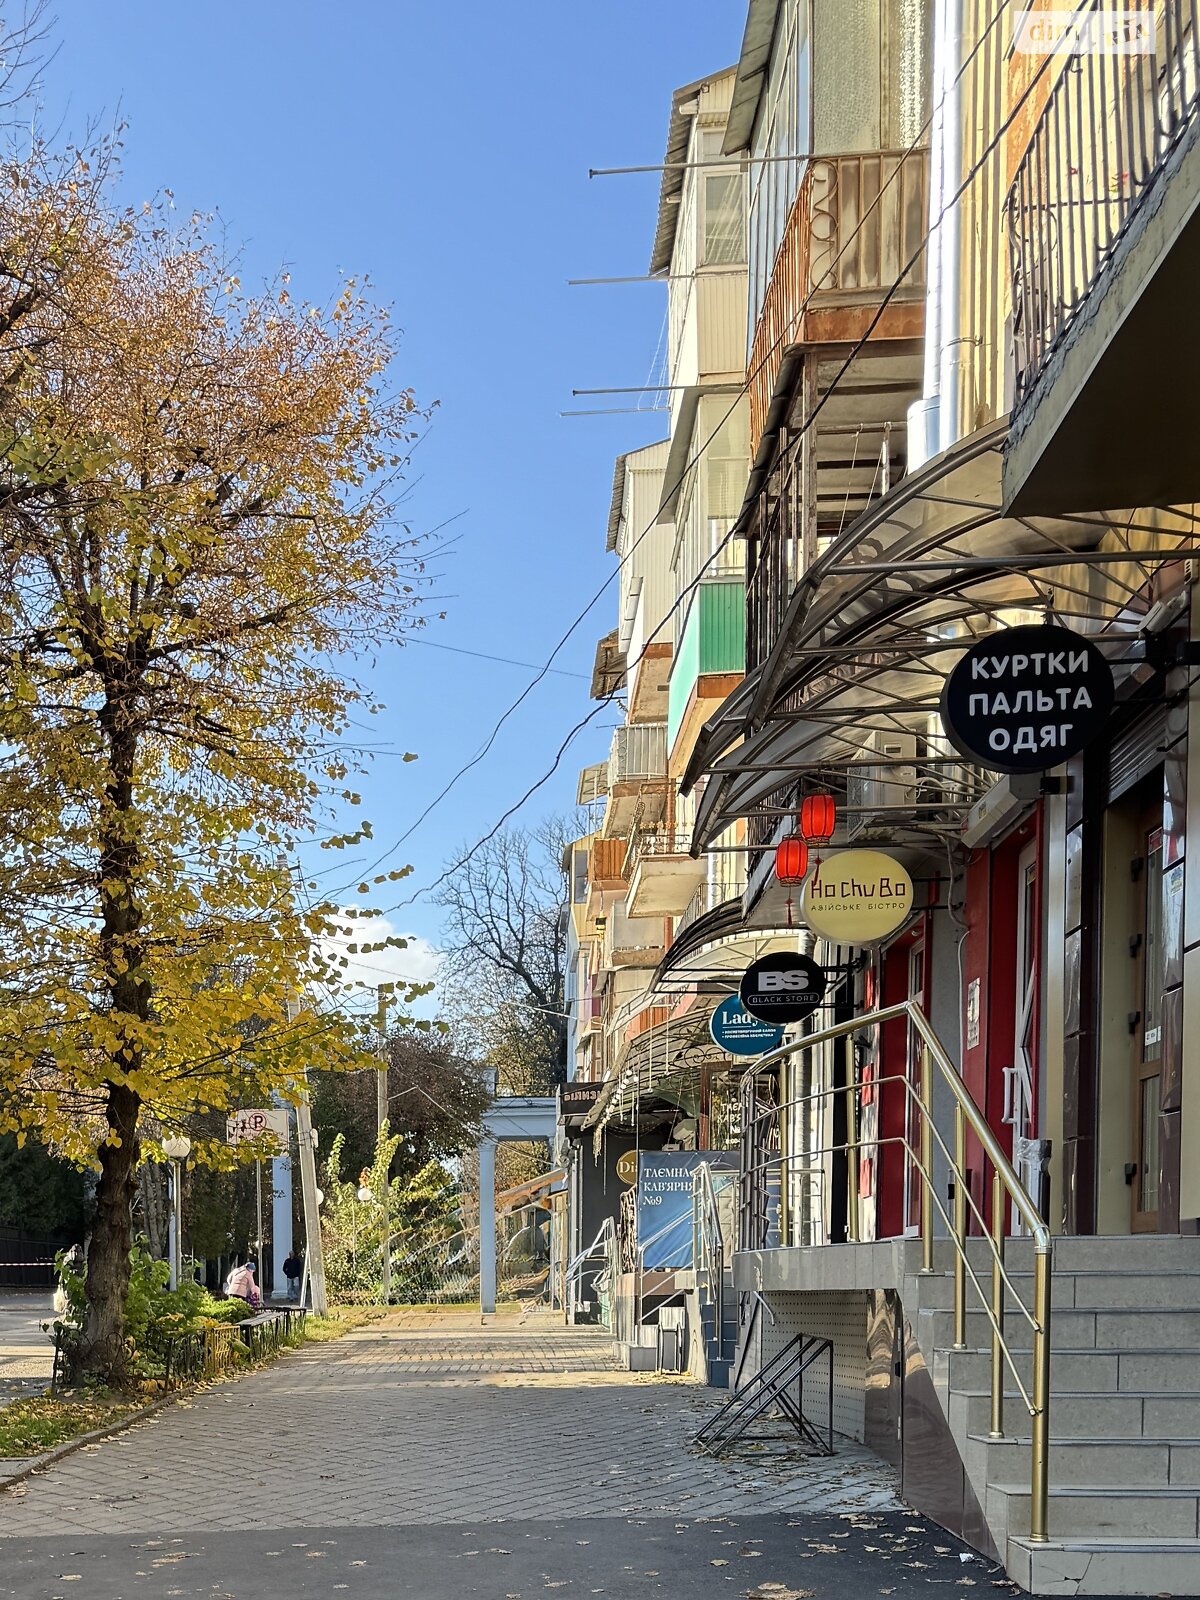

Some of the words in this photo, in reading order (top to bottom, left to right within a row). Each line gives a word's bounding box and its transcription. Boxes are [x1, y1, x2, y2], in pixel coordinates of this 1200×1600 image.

[971, 650, 1089, 680] КУРТКИ
[968, 686, 1093, 716] ПАЛЬТА
[988, 724, 1074, 754] ОДЯГ
[867, 902, 905, 910] БІСТРО
[758, 970, 809, 991] BS
[643, 1168, 689, 1178] ТАЄМНА
[643, 1196, 663, 1206] №9
